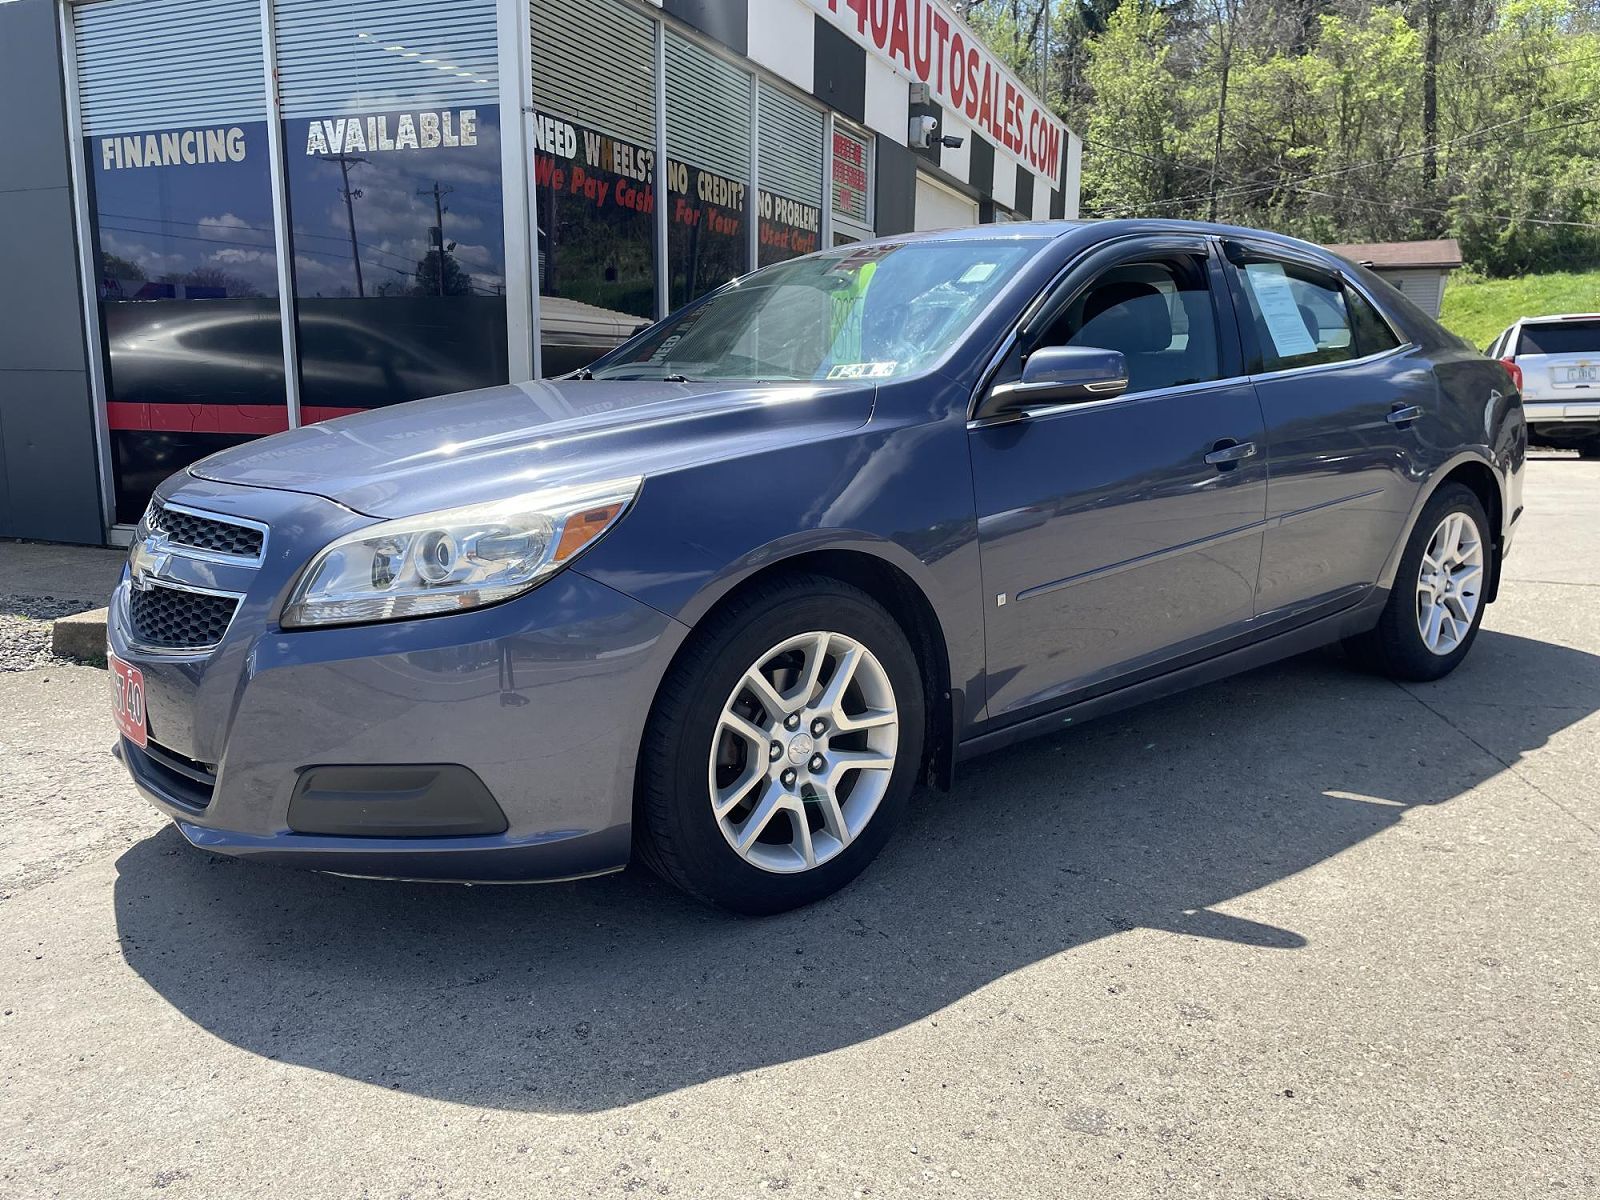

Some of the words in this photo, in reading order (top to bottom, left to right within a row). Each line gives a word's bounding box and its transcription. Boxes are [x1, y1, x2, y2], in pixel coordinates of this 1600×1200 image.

[101, 127, 246, 170] FINANCING
[306, 109, 477, 155] AVAILABLE
[828, 0, 1060, 182] 0AUTOSALES.COM
[532, 112, 577, 159] NEED
[583, 130, 654, 185] WHEELS?
[668, 160, 689, 195] NO
[697, 170, 745, 212] CREDIT?
[757, 191, 772, 219] NO
[775, 196, 819, 233] PROBLEM!
[534, 154, 564, 191] We
[571, 165, 609, 208] Pay
[615, 178, 654, 214] Cash
[674, 198, 700, 226] For
[707, 207, 738, 236] Your
[760, 222, 789, 249] Used
